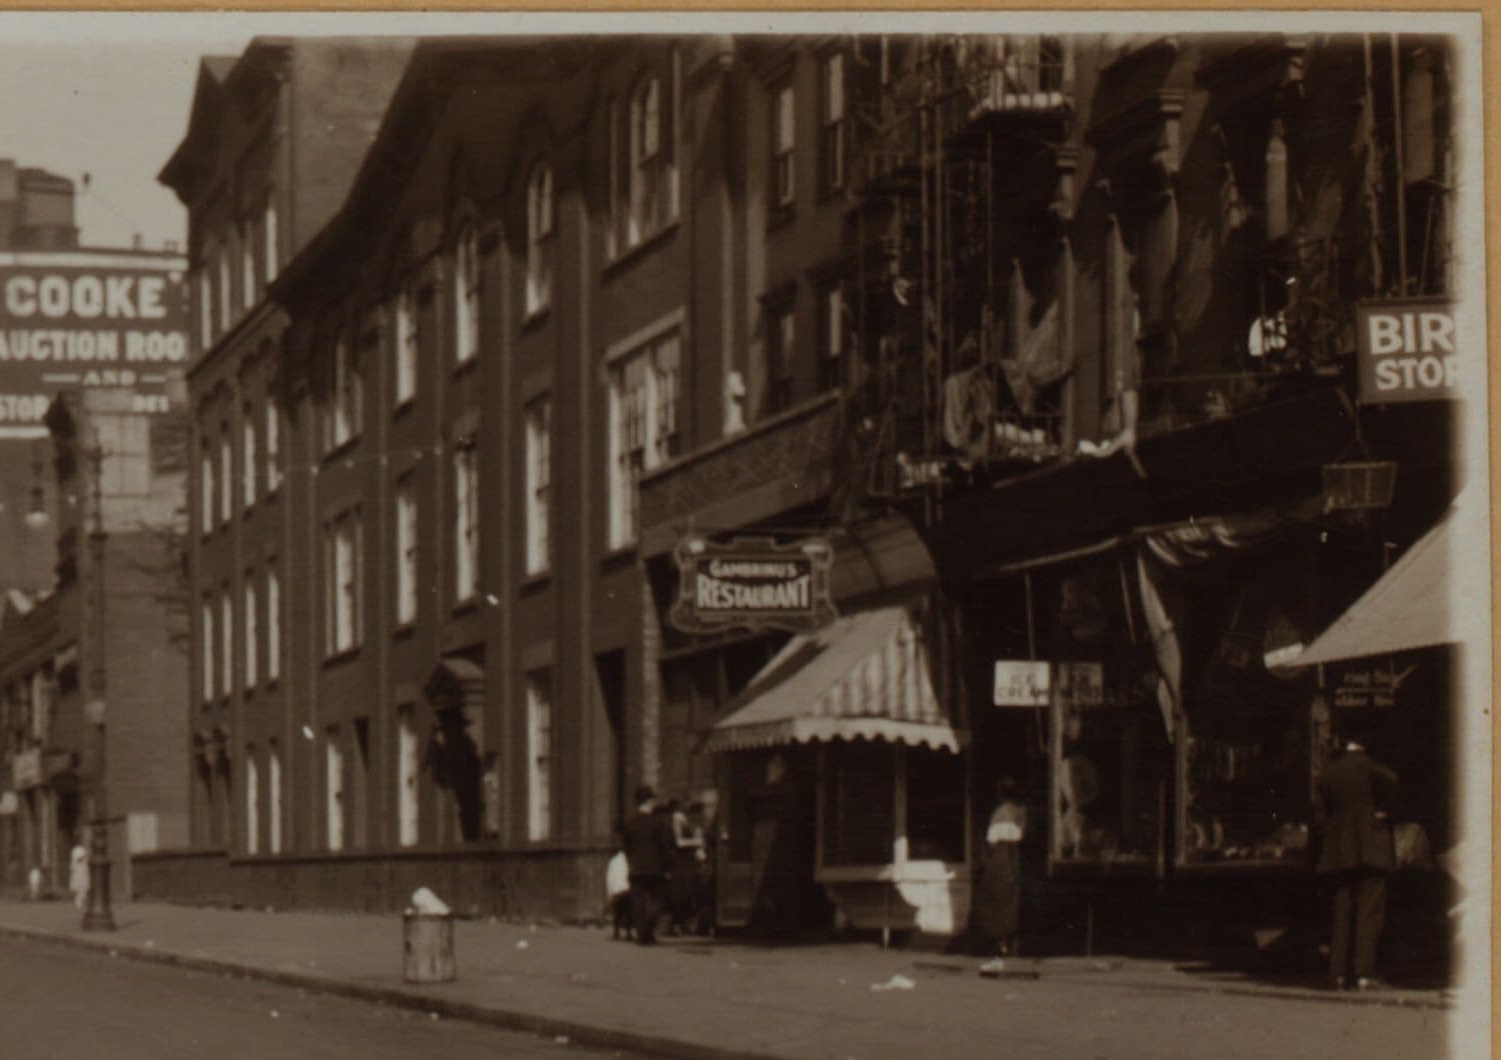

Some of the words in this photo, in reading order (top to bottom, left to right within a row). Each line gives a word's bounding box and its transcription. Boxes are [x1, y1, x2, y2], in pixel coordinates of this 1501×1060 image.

[5, 274, 188, 319] COOKE'
[83, 369, 137, 386] AND
[697, 573, 810, 609] RESTAURANT
